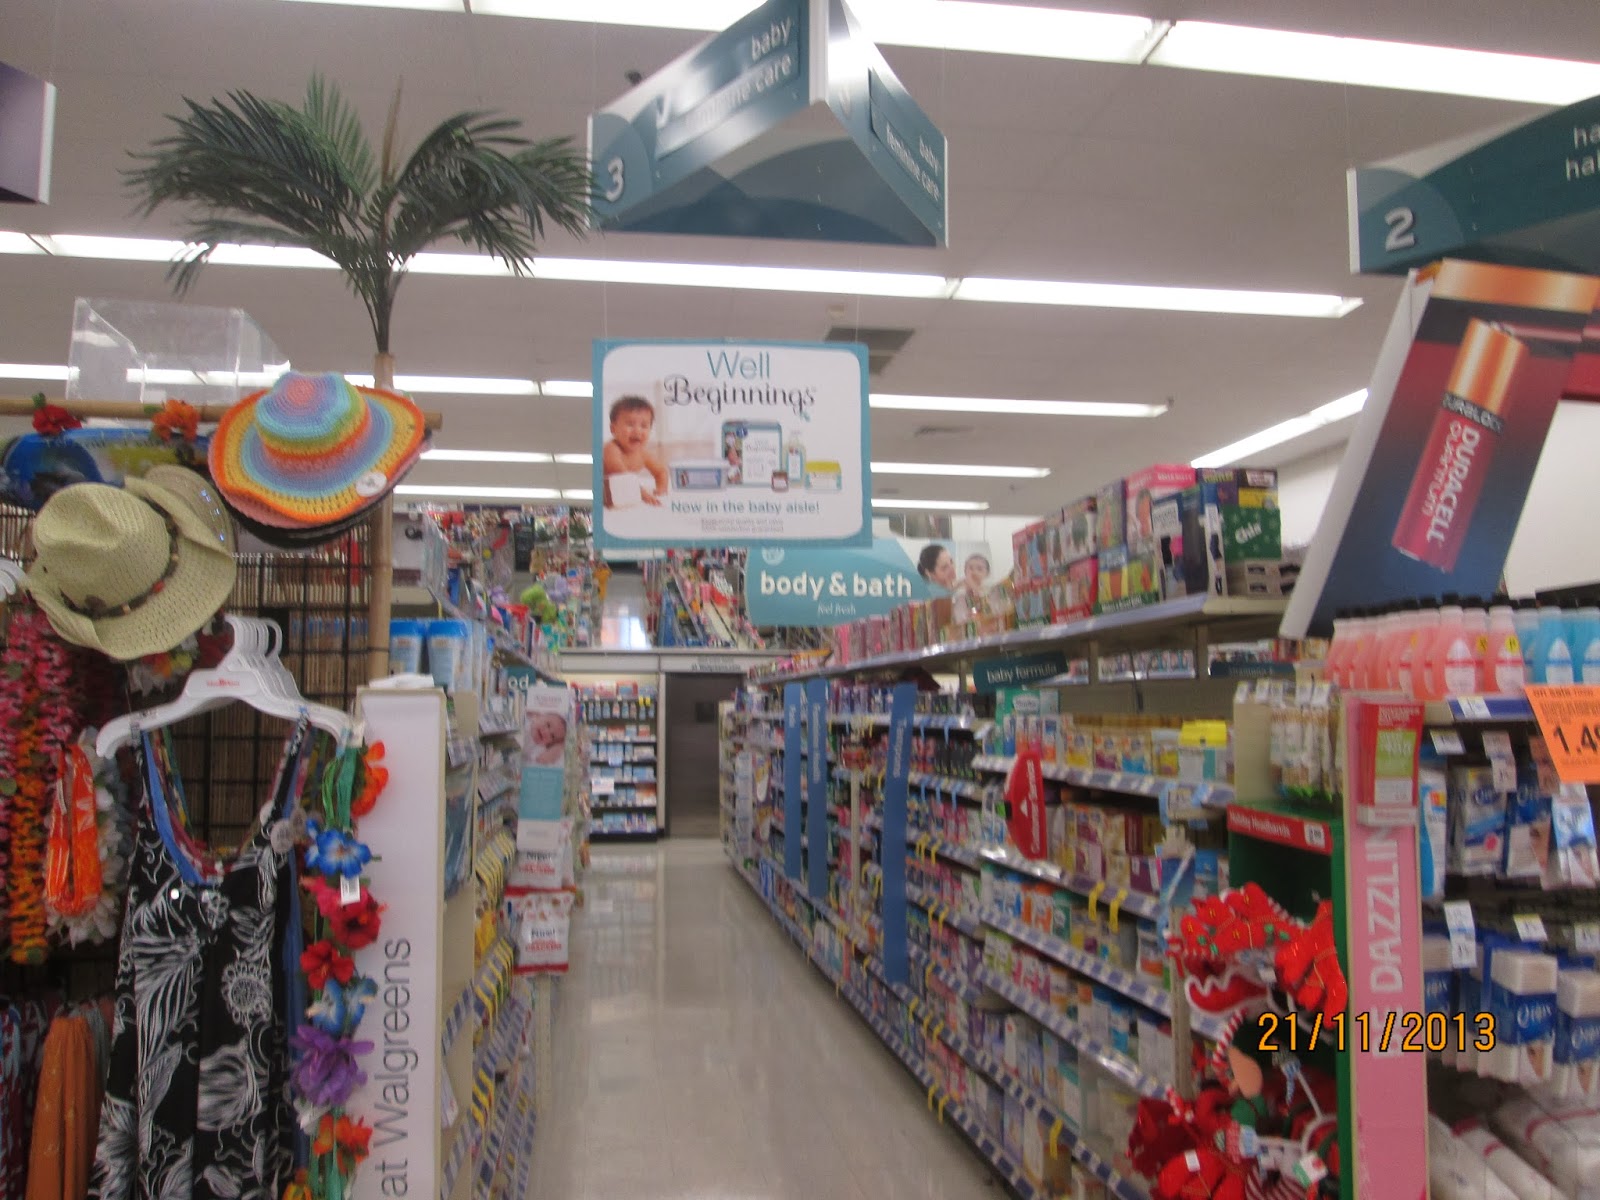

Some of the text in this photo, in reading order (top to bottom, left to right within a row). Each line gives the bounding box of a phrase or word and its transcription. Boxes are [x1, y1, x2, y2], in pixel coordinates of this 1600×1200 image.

[751, 16, 792, 61] baby
[605, 156, 626, 202] 3
[921, 170, 940, 202] care
[1384, 207, 1416, 252] 2
[706, 350, 771, 379] Well
[663, 374, 816, 415] Beginnings
[1427, 425, 1482, 544] DURACELL
[671, 500, 820, 515] Now in the baby aisle!
[760, 570, 912, 601] body & bath
[986, 663, 1058, 684] baby formula
[373, 937, 419, 1198] at Walgreens
